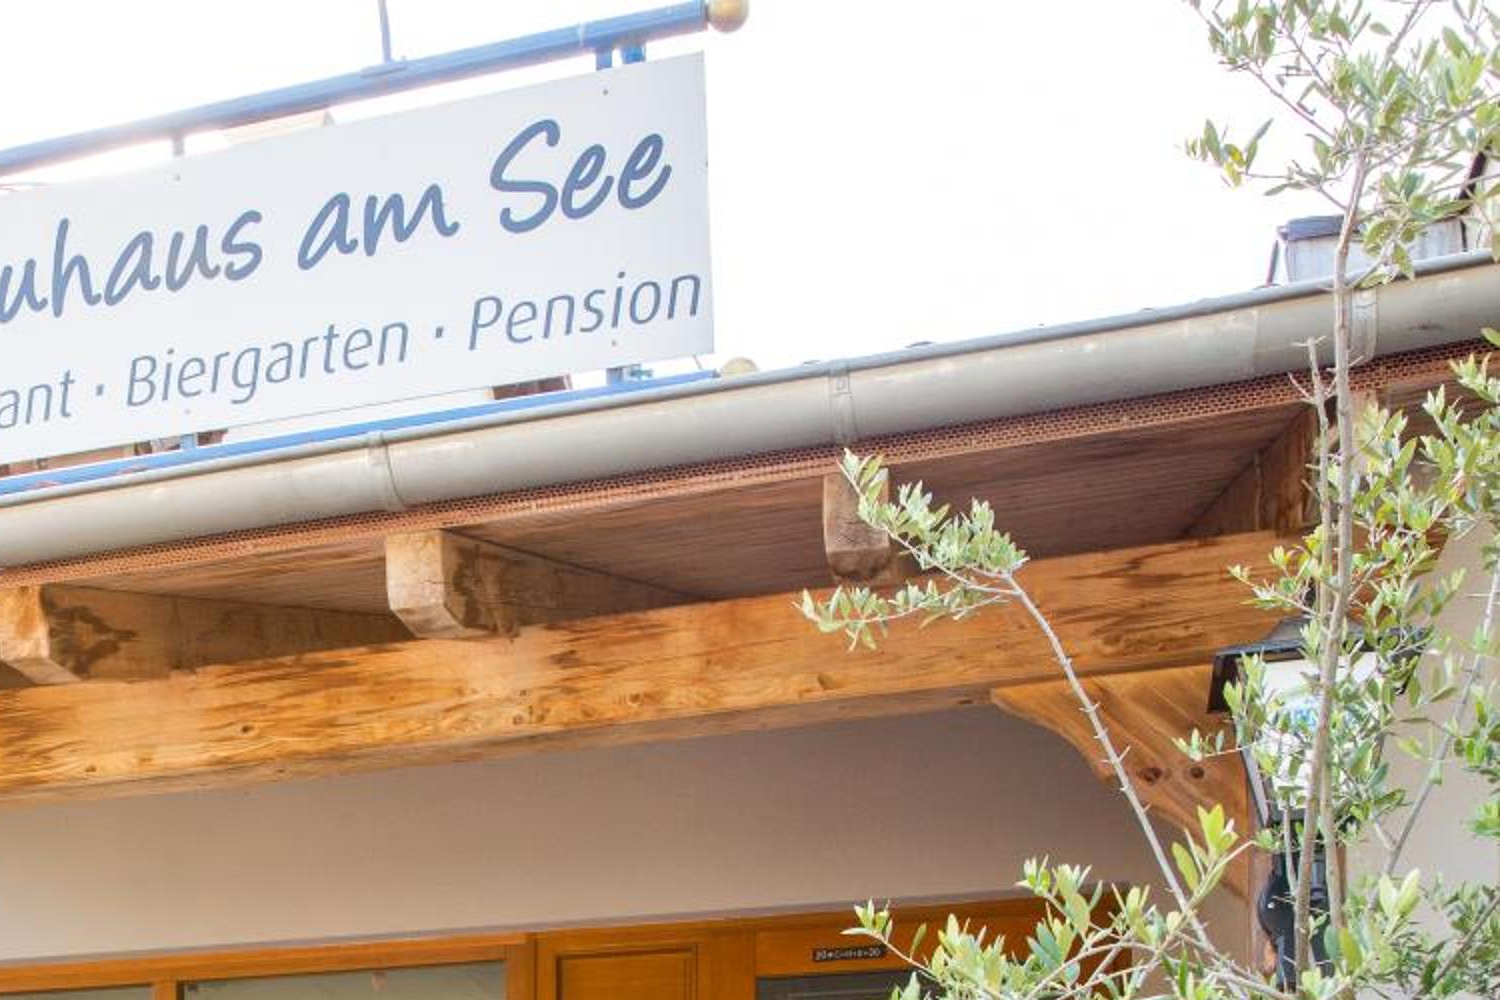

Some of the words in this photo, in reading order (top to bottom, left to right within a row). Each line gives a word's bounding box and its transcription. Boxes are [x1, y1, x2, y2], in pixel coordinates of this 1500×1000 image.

[297, 183, 461, 271] am
[489, 118, 673, 235] See
[127, 322, 409, 407] Biergarten
[468, 273, 701, 351] Pension
